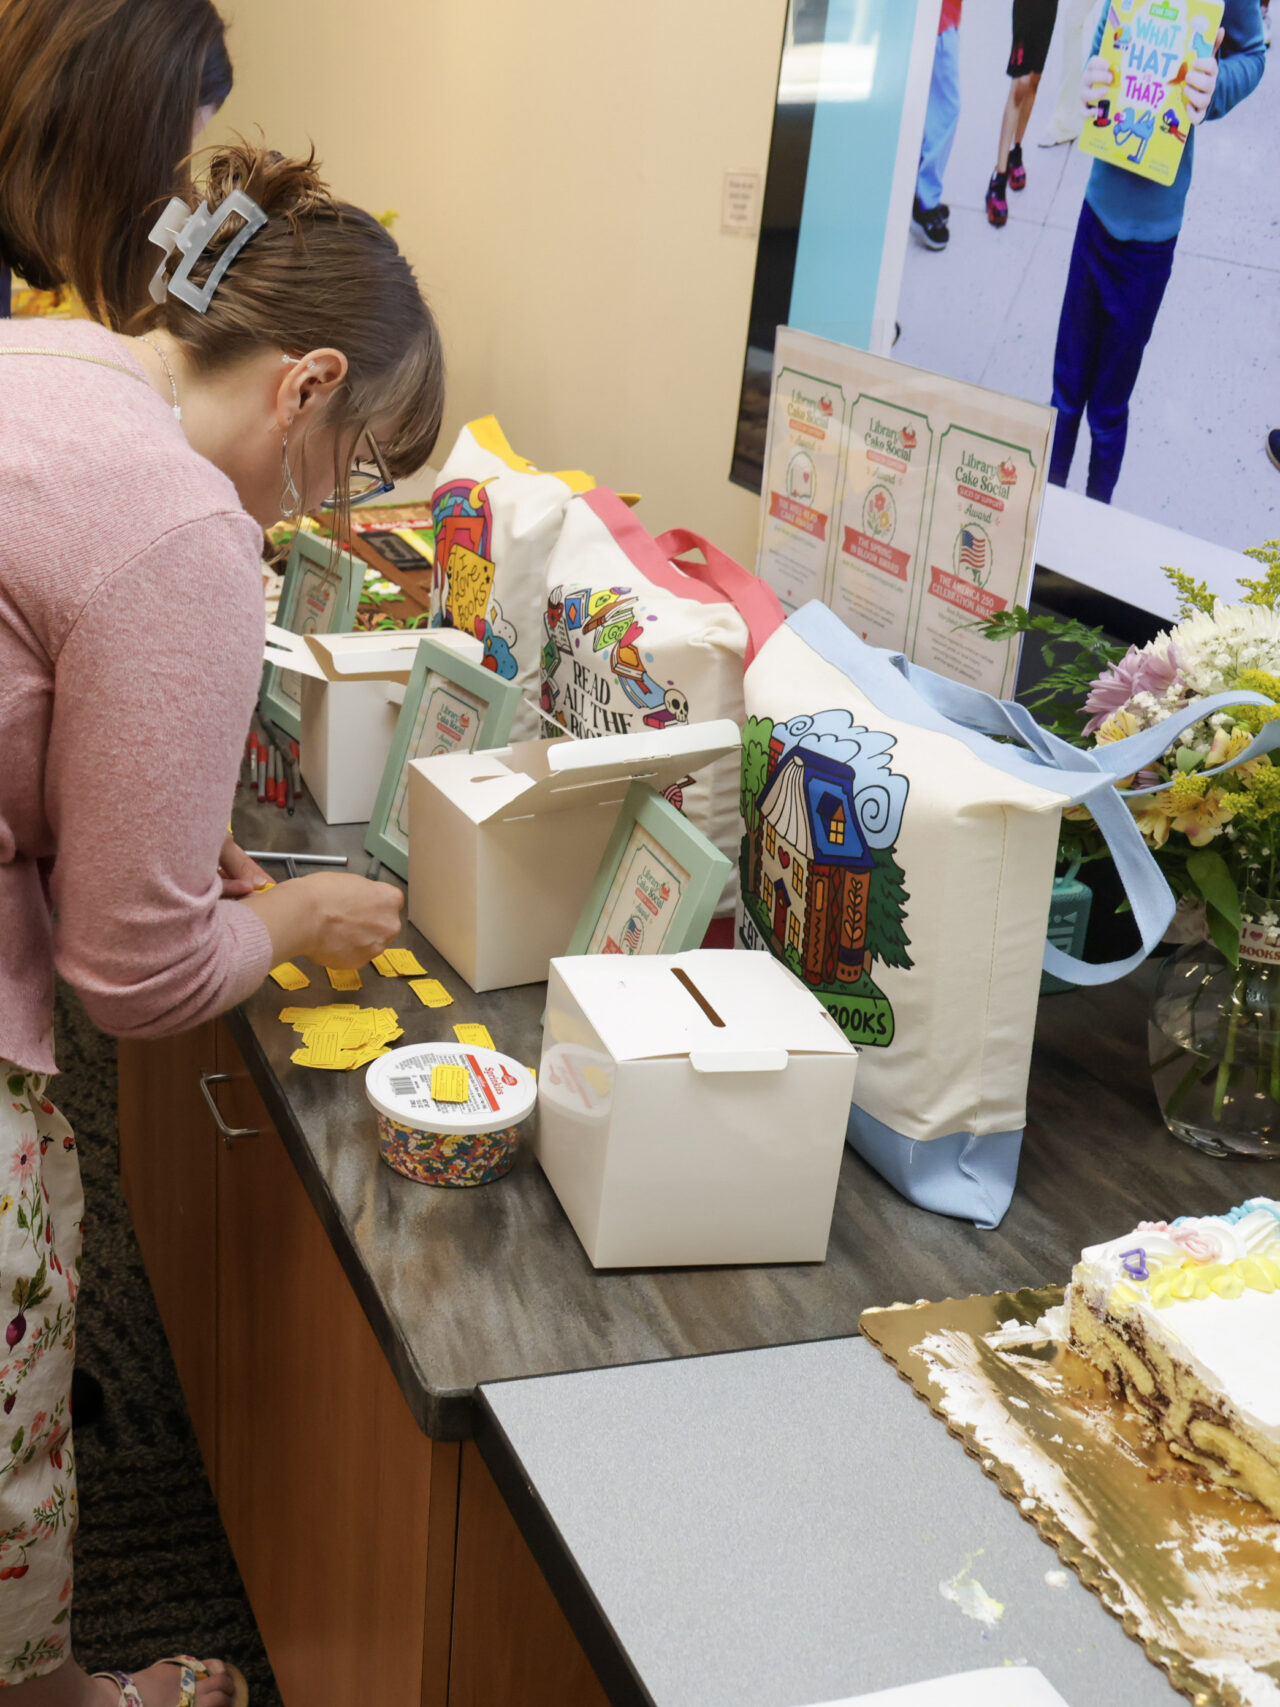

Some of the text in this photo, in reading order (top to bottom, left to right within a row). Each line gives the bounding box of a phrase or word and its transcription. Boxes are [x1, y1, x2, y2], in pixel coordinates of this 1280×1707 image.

[1136, 16, 1182, 50] WHAT
[1128, 43, 1178, 78] HAT
[1125, 75, 1165, 109] THAT?
[869, 417, 898, 444] Library
[864, 432, 885, 451] Cake
[886, 440, 911, 462] Social
[961, 450, 997, 480] Library
[955, 466, 1010, 500] Cake Social
[964, 504, 992, 524] Award
[459, 554, 467, 571] I
[932, 582, 975, 610] CELEBRATION
[940, 574, 952, 586] THE
[952, 579, 980, 600] AMERICA
[573, 659, 611, 706] READ
[563, 683, 587, 722] ALL
[590, 700, 633, 735] THE
[1242, 927, 1248, 939] I
[483, 1066, 504, 1095] Sprinkles
